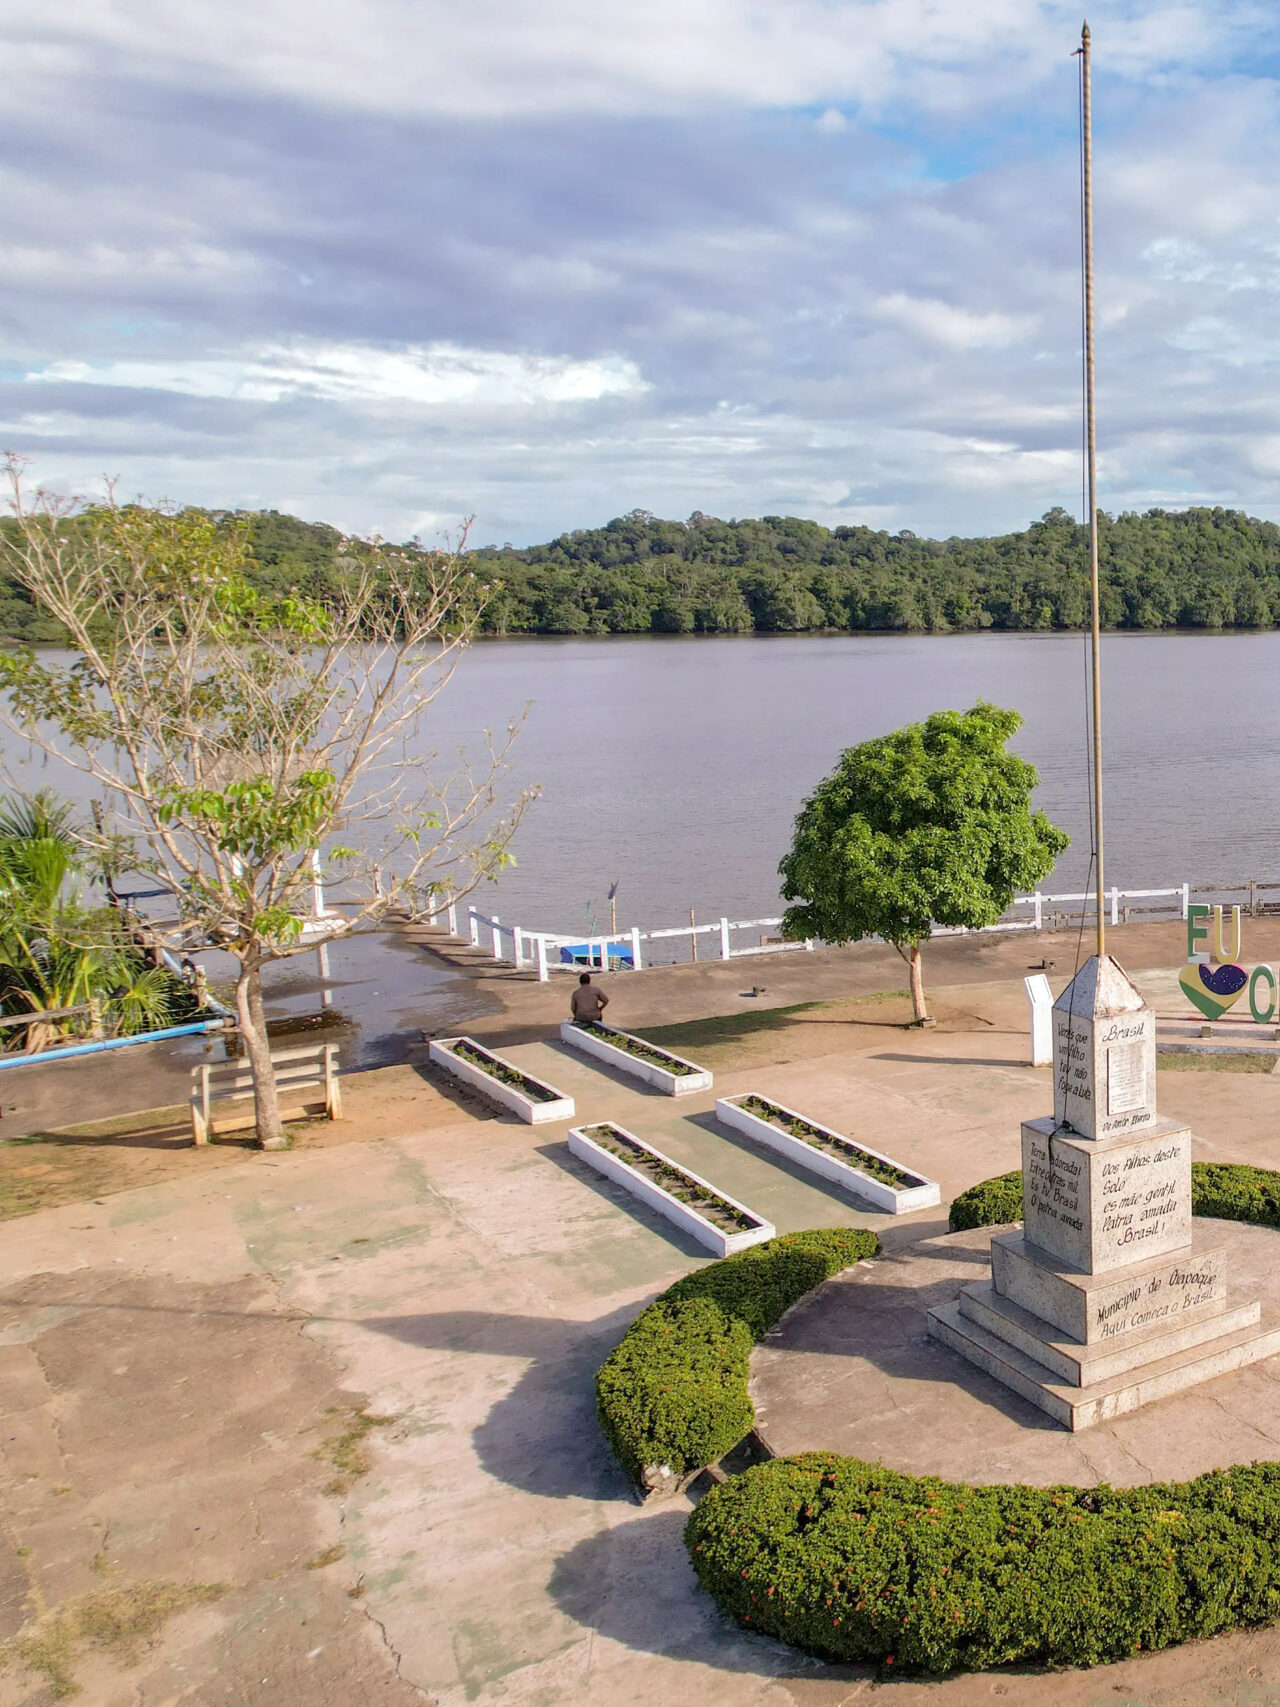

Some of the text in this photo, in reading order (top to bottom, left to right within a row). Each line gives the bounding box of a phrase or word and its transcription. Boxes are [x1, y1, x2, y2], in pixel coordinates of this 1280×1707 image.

[1187, 904, 1240, 965] EU
[1075, 1033, 1088, 1045] que
[1102, 1022, 1144, 1042] Brasil
[1031, 1142, 1046, 1161] Terra
[1102, 1163, 1120, 1177] Dos
[1153, 1146, 1181, 1163] deste
[1103, 1177, 1126, 1195] Solo
[1143, 1180, 1177, 1206] gentil
[1053, 1188, 1079, 1211] Brasil
[1140, 1199, 1177, 1221] amada
[1060, 1213, 1083, 1231] amada
[1148, 1276, 1162, 1294] de
[1101, 1318, 1126, 1338] Aqui
[1171, 1302, 1179, 1312] o
